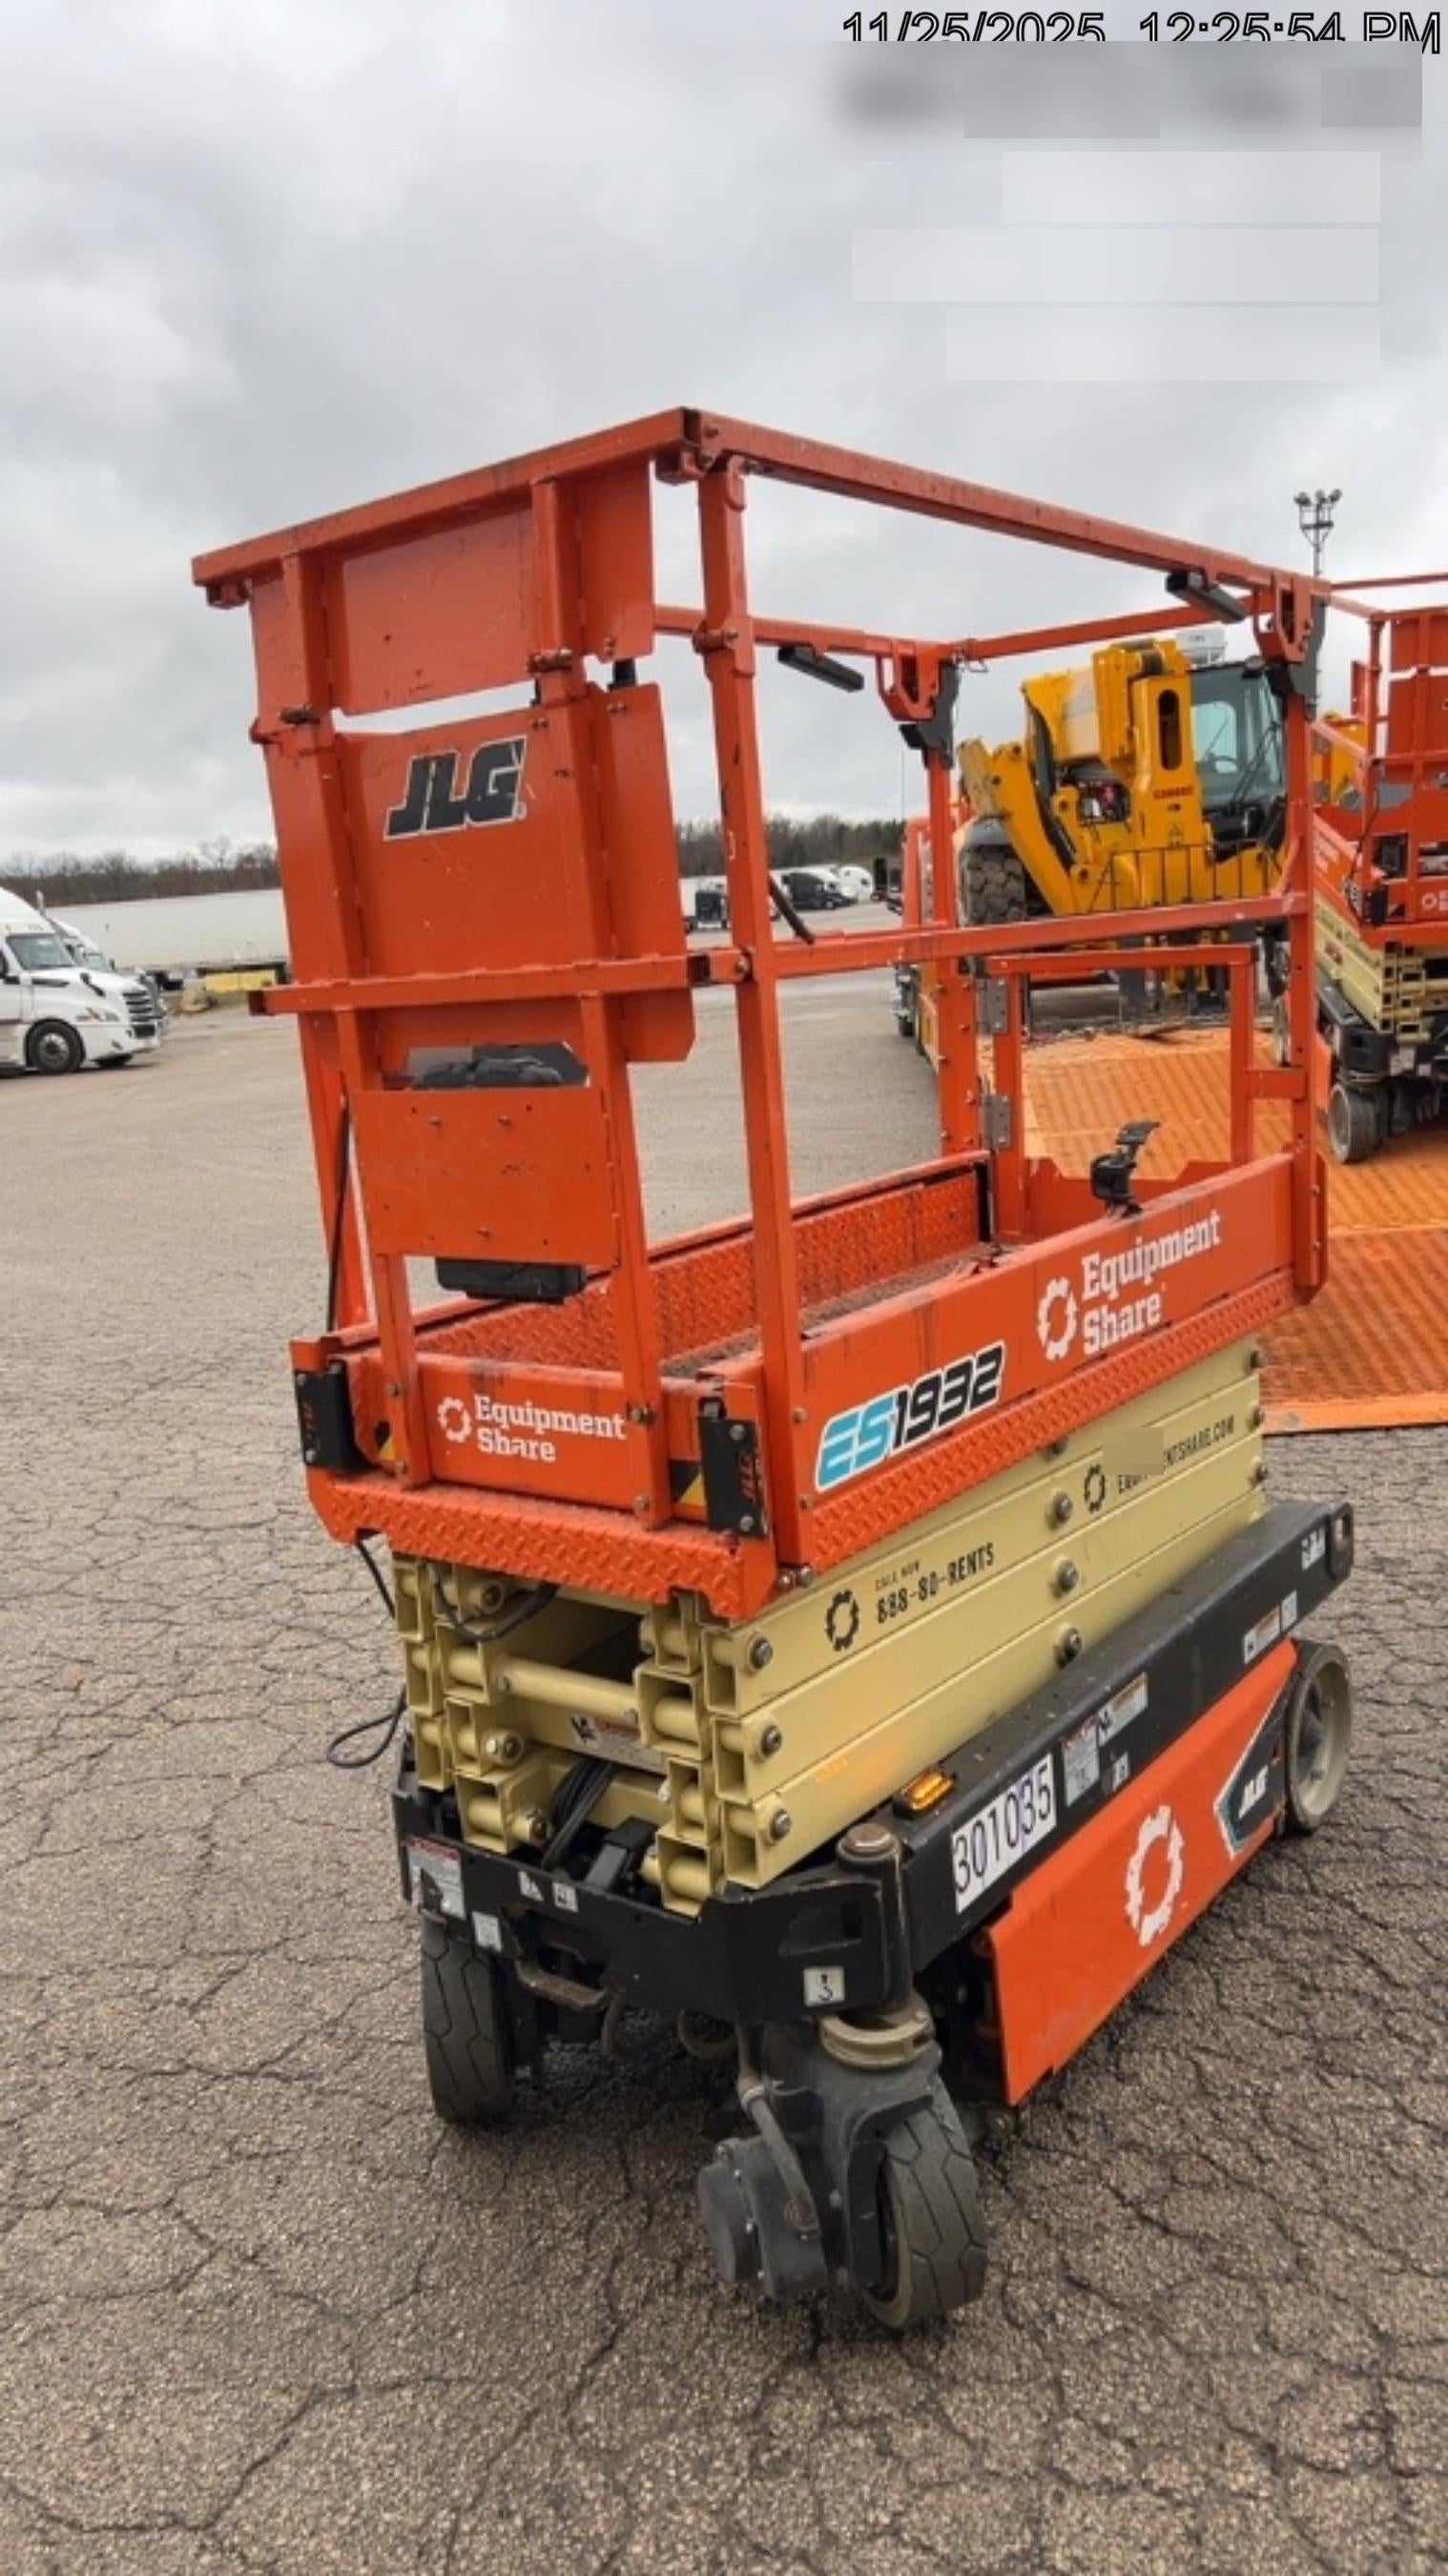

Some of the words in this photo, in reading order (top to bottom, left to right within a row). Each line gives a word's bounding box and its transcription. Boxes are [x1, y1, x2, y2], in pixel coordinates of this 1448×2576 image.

[383, 735, 527, 841] JLG
[1082, 1210, 1221, 1300] Equipment
[1084, 1293, 1161, 1355] Share
[474, 1393, 627, 1441] Equipment
[477, 1427, 556, 1463] Share
[816, 1340, 1005, 1493] ES1932
[877, 1542, 994, 1624] 888-80-RENTS
[955, 1762, 1051, 1893] 301035
[1238, 1765, 1269, 1821] JLG
